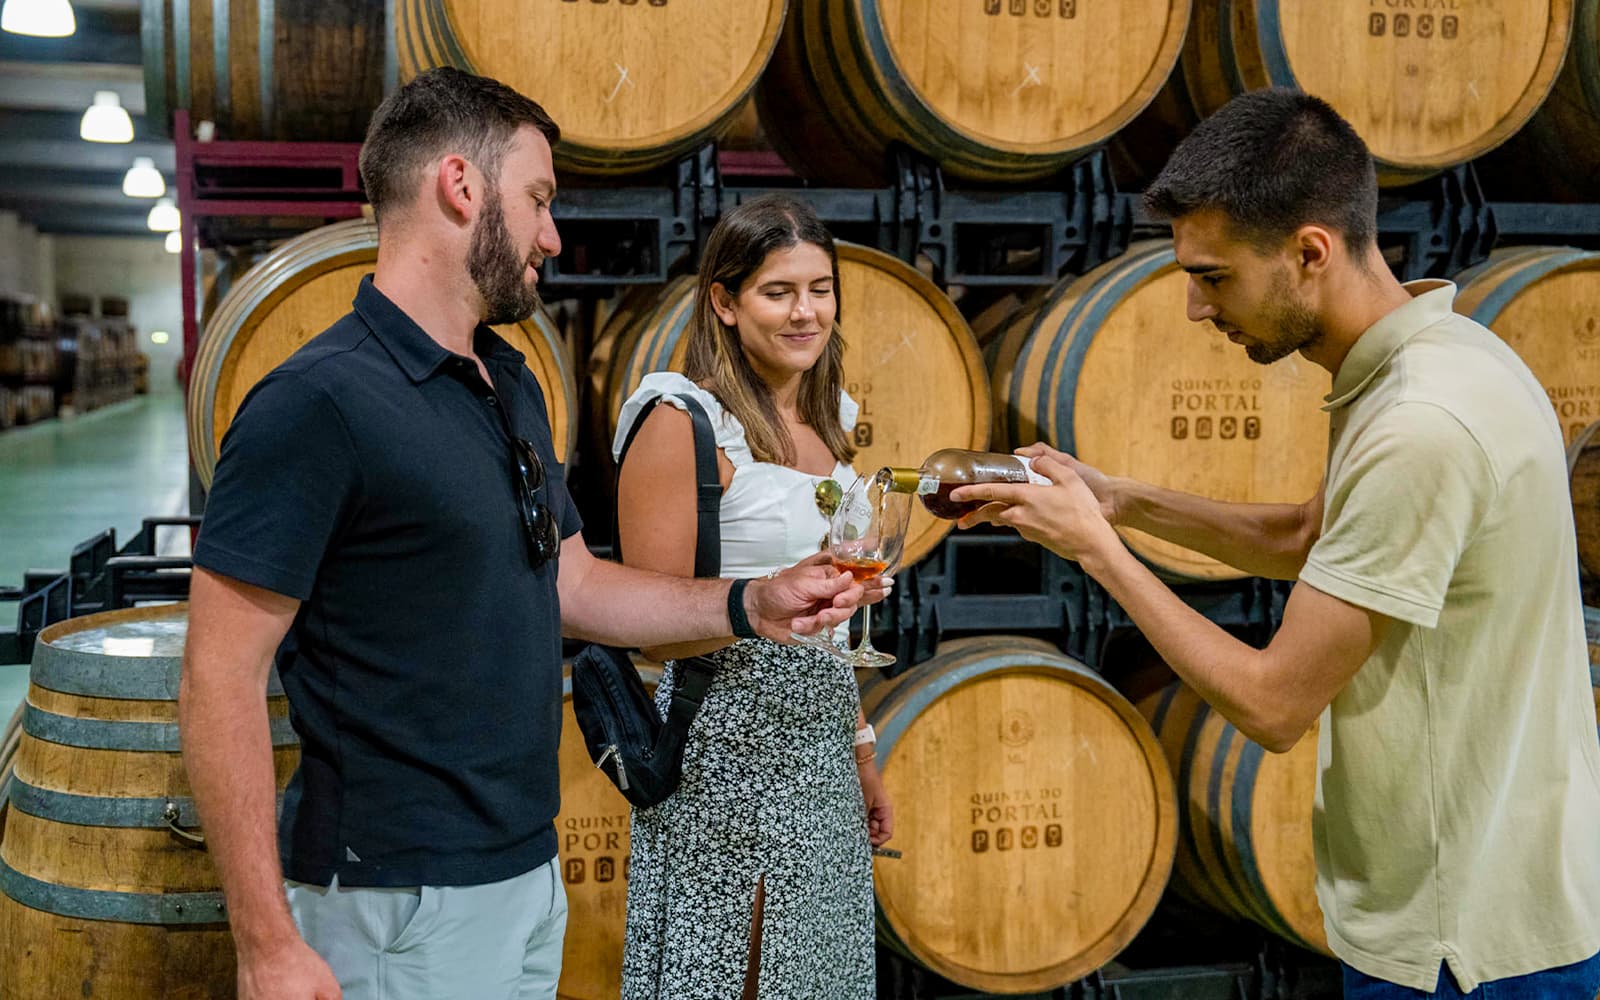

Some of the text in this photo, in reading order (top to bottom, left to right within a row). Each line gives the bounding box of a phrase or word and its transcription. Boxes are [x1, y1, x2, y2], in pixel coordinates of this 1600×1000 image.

[1171, 379, 1232, 392] QUINTA
[1547, 386, 1600, 399] QUINT
[1171, 393, 1262, 411] PORTAL
[970, 787, 1063, 805] QUINTA DO
[565, 815, 630, 831] QUINT
[970, 803, 1063, 825] PORTAL
[565, 831, 630, 852] POR
